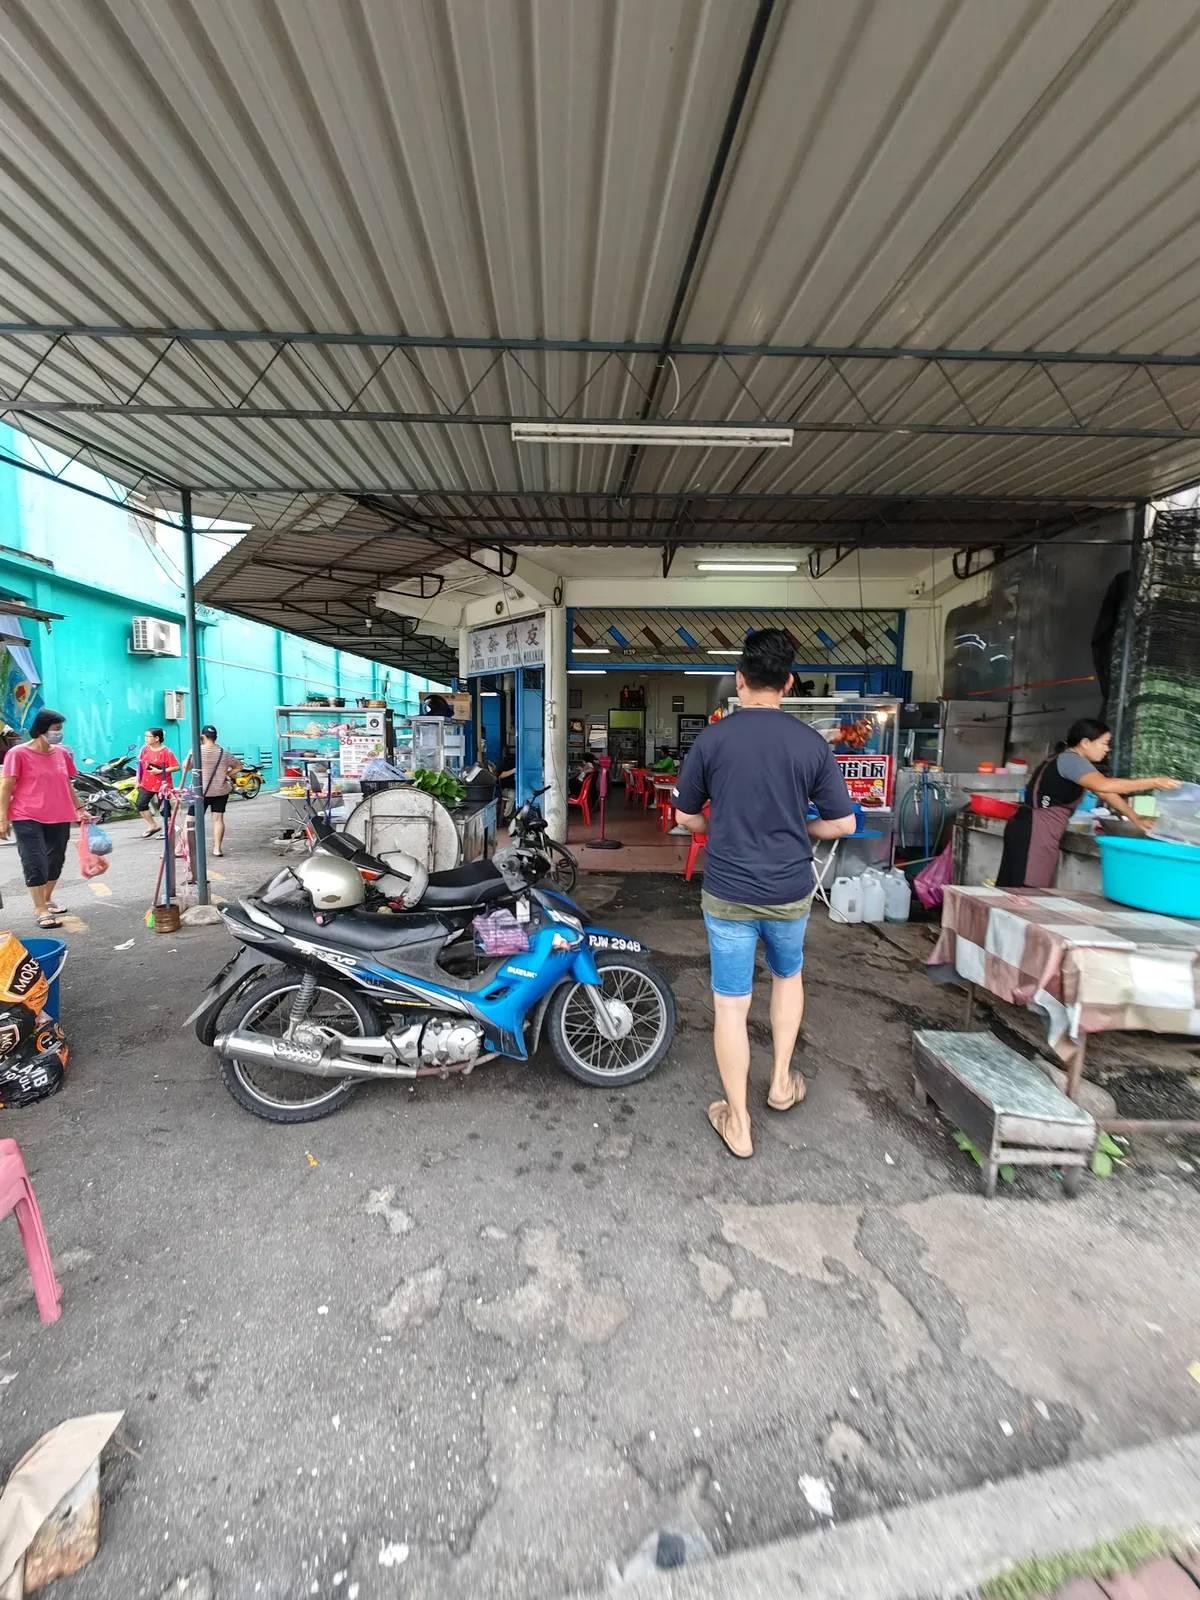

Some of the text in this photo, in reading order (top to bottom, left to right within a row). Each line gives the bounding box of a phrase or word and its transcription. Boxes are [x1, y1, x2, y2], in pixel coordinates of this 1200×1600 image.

[611, 937, 641, 952] 2948
[13, 957, 40, 993] MORE
[506, 965, 538, 979] SUZUKI
